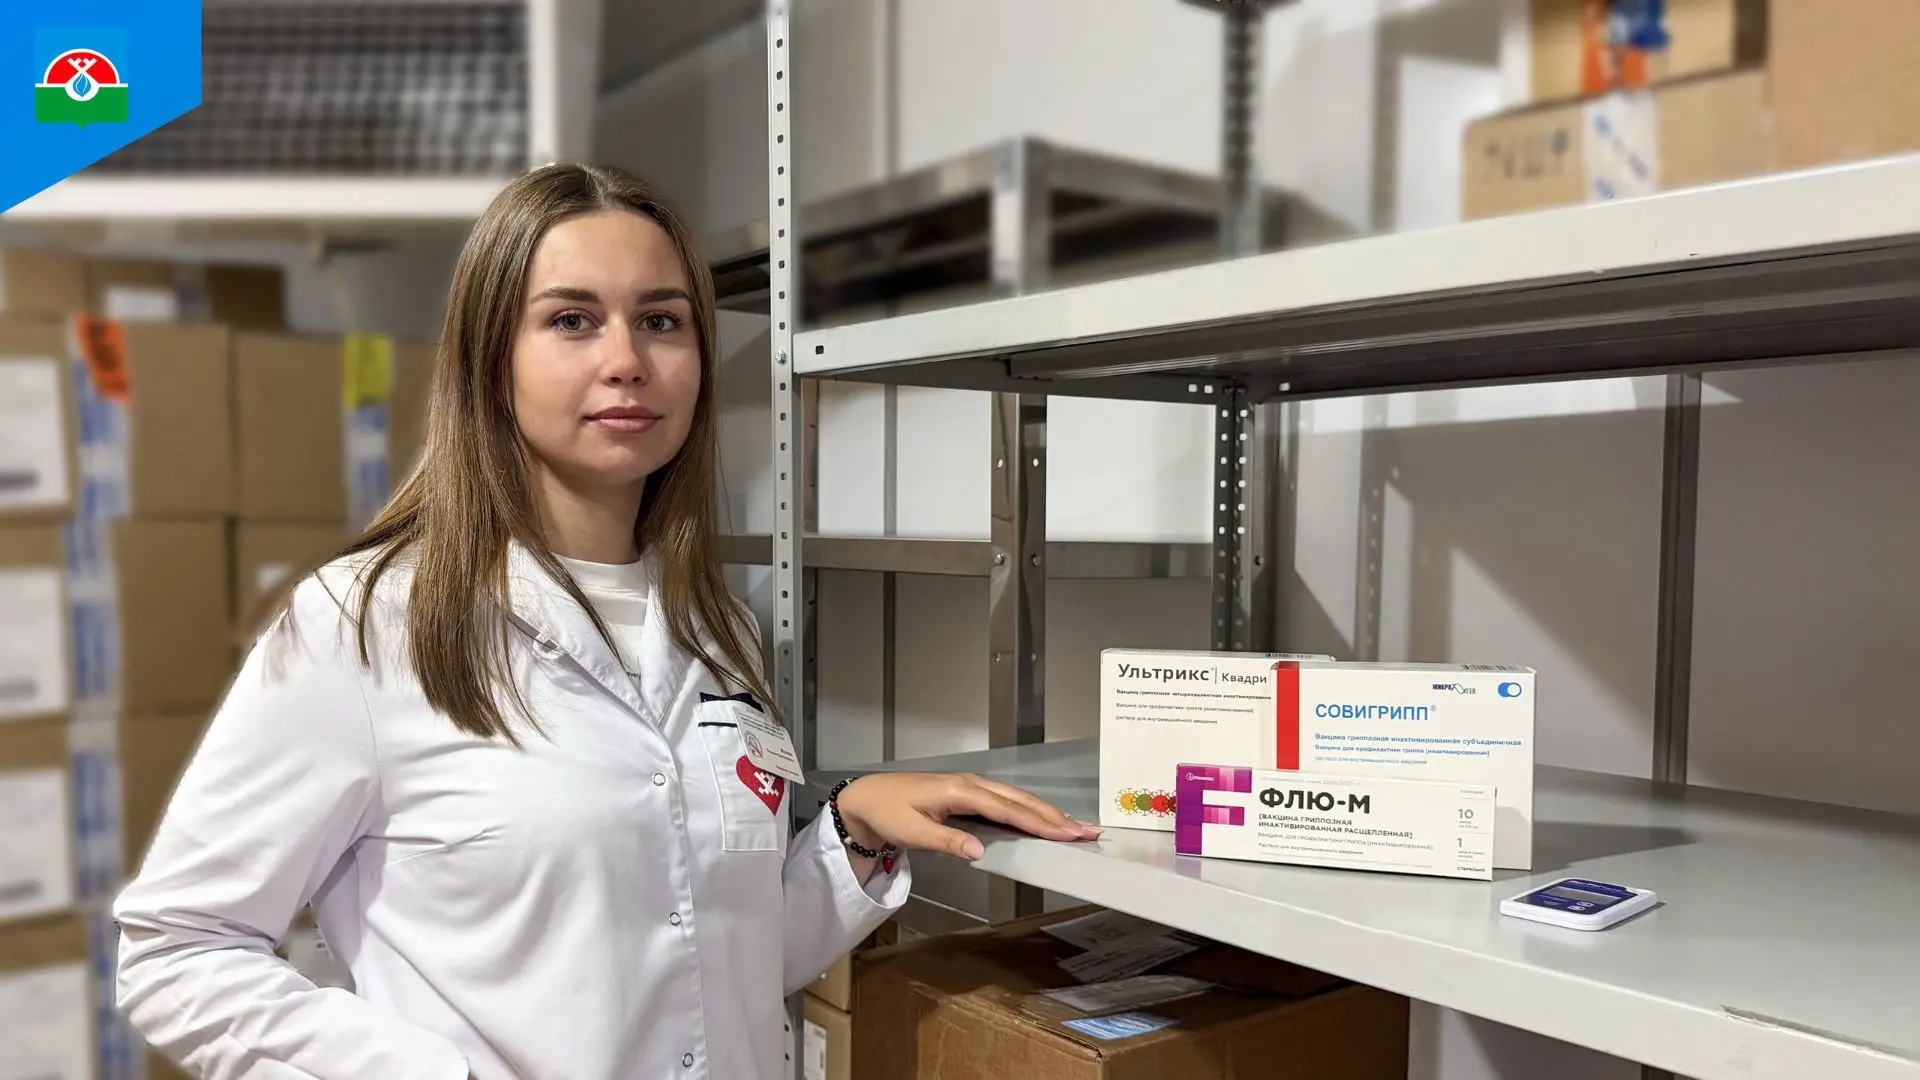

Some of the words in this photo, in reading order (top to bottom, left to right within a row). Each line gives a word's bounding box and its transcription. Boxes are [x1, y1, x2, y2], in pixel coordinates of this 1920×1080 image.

[1118, 664, 1209, 682] Ультрикс
[1222, 673, 1267, 685] Квадри
[1315, 733, 1346, 741] Вакцина
[1463, 738, 1522, 746] субъединичная
[1259, 788, 1370, 814] ФЛЮ-М
[1259, 813, 1299, 821] [ВАКЦИНА
[1300, 816, 1352, 825] ГРИППОЗНАЯ
[1458, 808, 1474, 819] 10
[1259, 821, 1342, 832] ИНАКТИВИРОВАННАЯ
[1344, 828, 1413, 839] РАСЩЕПЛЕННАЯ]
[1457, 838, 1463, 848] 1
